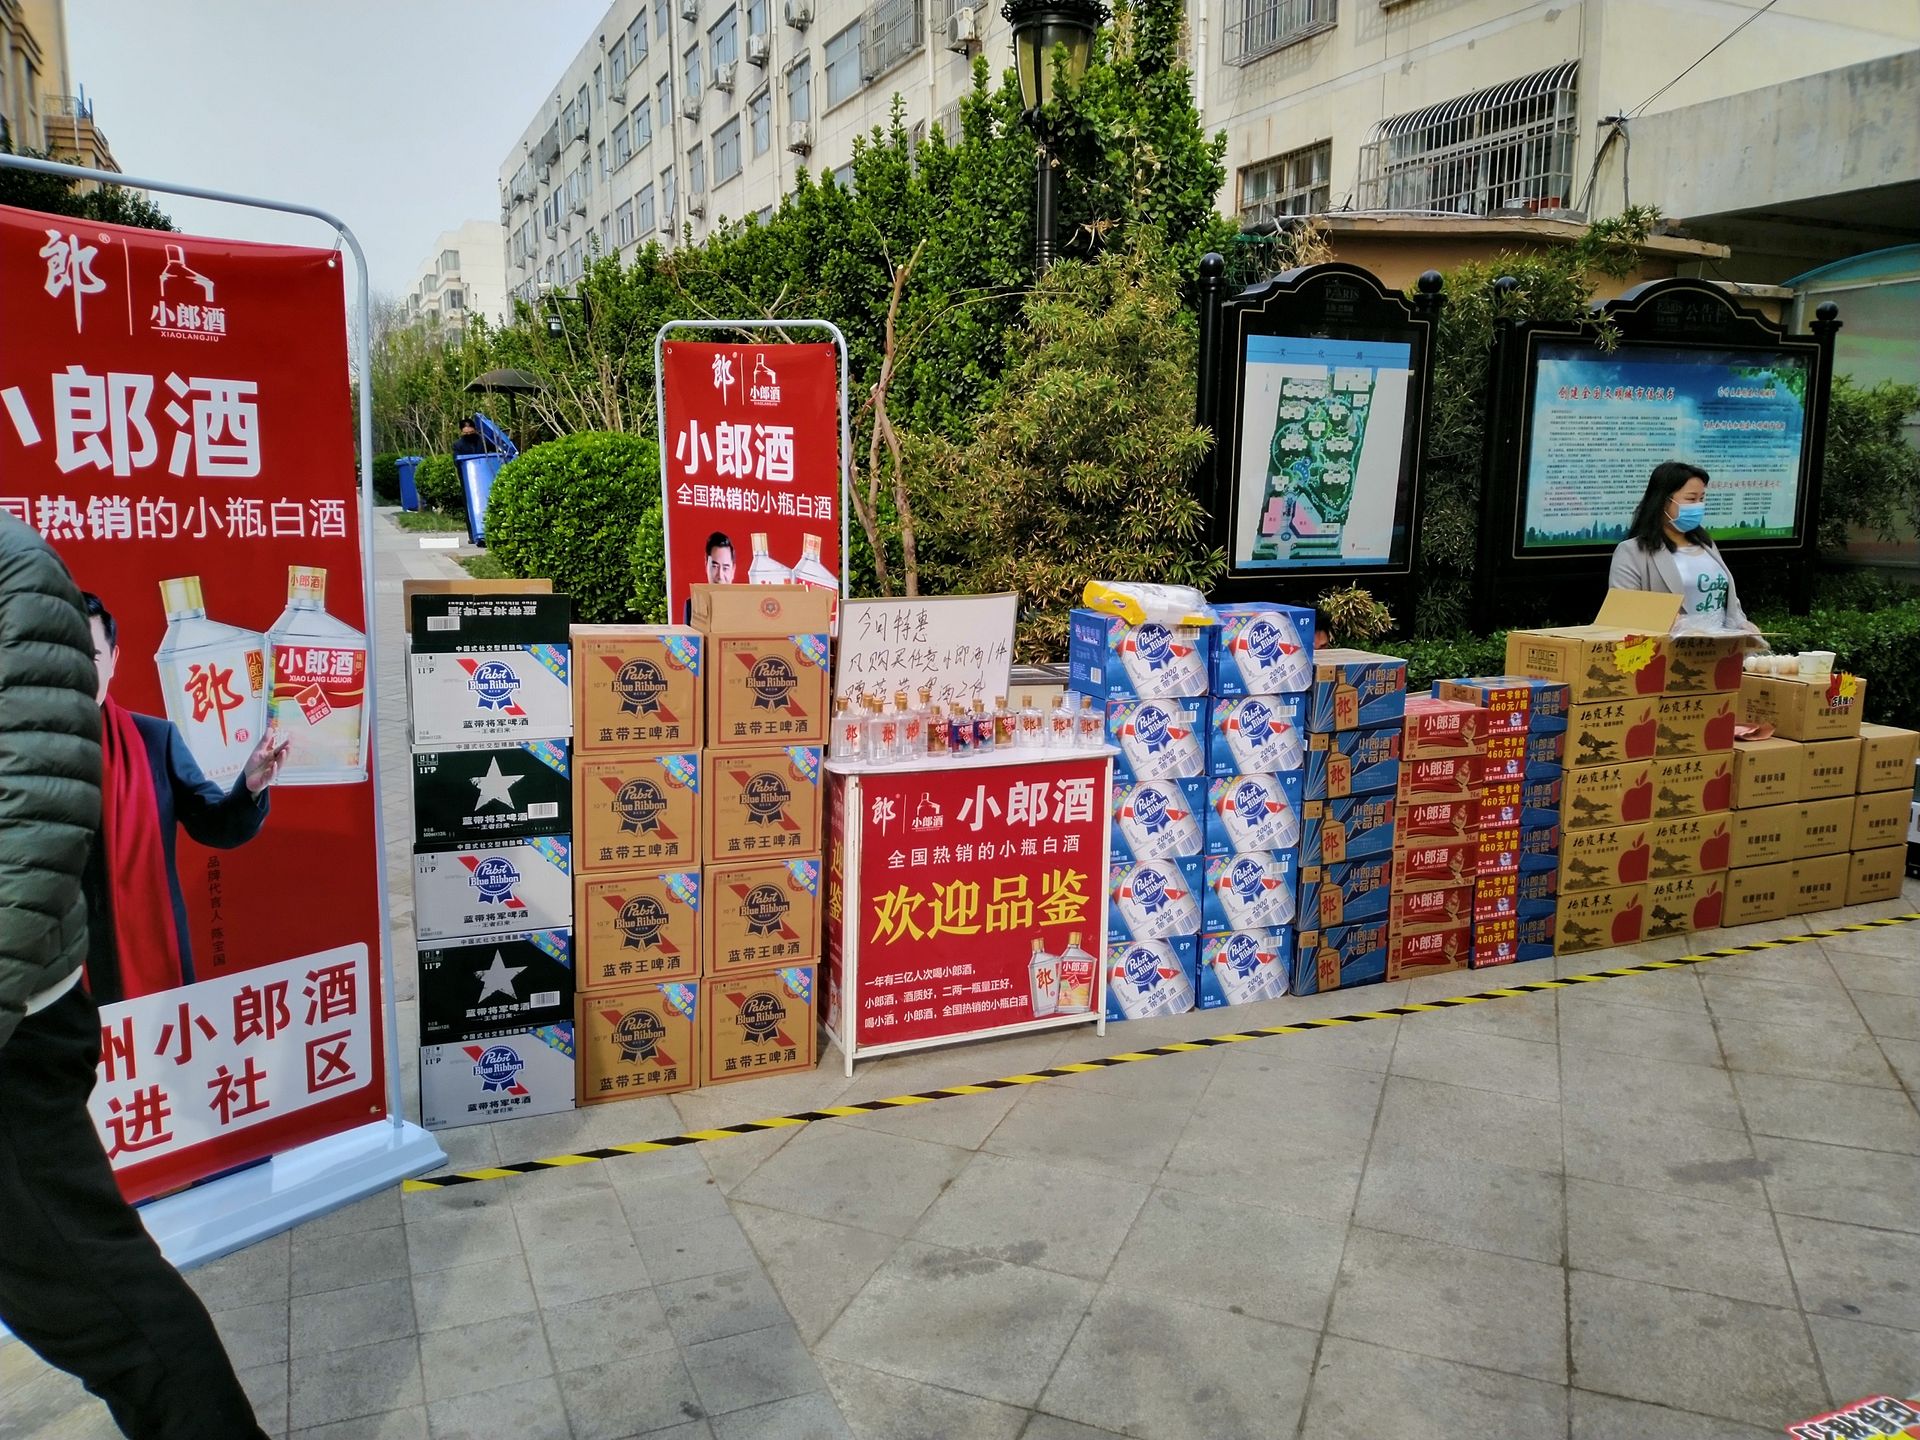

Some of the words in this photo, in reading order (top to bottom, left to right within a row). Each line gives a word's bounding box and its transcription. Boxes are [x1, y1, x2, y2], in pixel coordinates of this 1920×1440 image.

[39, 229, 106, 334] 郎
[150, 301, 226, 332] 小郎酒
[160, 331, 219, 342] XIAOLANGJIU
[712, 353, 735, 406] 郎
[750, 385, 780, 401] 小郎酒
[675, 420, 794, 482] 小郎酒
[676, 483, 832, 520] 全国热销的小瓶白酒
[290, 575, 321, 589] 小郎酒
[858, 606, 929, 643] 今日特惠
[279, 648, 353, 676] 小郎酒
[480, 667, 506, 679] Pabst
[625, 667, 653, 681] Pabst
[758, 664, 785, 677] Pabst
[1160, 667, 1178, 682] 2000
[1365, 668, 1397, 681] 小郎酒
[469, 680, 489, 690] Blue
[490, 678, 518, 689] Ribbon
[614, 681, 632, 692] Blue
[635, 680, 666, 691] Ribbon
[748, 677, 765, 688] Blue
[767, 675, 796, 687] Ribbon
[184, 662, 244, 748] 郎
[1337, 697, 1352, 725] 郎
[463, 718, 529, 728] 蓝带将军啤酒
[734, 720, 808, 736] 蓝带王啤酒
[1424, 714, 1460, 731] 小郎酒
[599, 725, 679, 742] 蓝带王啤酒
[1359, 737, 1390, 750] 小郎酒
[1418, 760, 1454, 777] 小郎酒
[752, 780, 778, 793] Pabst
[1330, 765, 1345, 792] 郎
[625, 785, 653, 799] Pabst
[741, 794, 758, 804] Blue
[760, 792, 789, 802] Ribbon
[613, 801, 632, 812] Blue
[635, 800, 666, 810] Ribbon
[956, 777, 1095, 832] 小郎酒
[1352, 803, 1385, 817] 小郎酒
[462, 812, 528, 825] 蓝带将军啤酒
[872, 796, 896, 837] 郎
[1414, 805, 1451, 821] 小郎酒
[912, 815, 944, 828] 小郎酒
[728, 833, 801, 851] 蓝带王啤酒
[599, 842, 678, 861] 蓝带王啤酒
[888, 834, 1080, 868] 全国热销的小瓶白酒
[1412, 849, 1449, 866] 小郎酒
[481, 864, 507, 875] Pabst
[1350, 866, 1381, 879] 小郎酒
[470, 877, 489, 886] Blue
[490, 873, 518, 884] Ribbon
[207, 856, 223, 922] 品牌代言人
[870, 868, 1090, 946] 欢迎品鉴
[1409, 892, 1444, 909] 小郎酒
[464, 910, 528, 923] 蓝带将军啤酒
[627, 902, 655, 917] Pabst
[616, 919, 636, 929] Blue
[637, 915, 668, 926] Ribbon
[211, 928, 225, 967] 陈宝国
[1408, 934, 1443, 952] 小郎酒
[728, 942, 800, 962] 蓝带王啤酒
[603, 956, 681, 977] 蓝带王啤酒
[1062, 962, 1088, 973] 小郎酒
[1036, 968, 1054, 1000] 郎
[466, 1002, 530, 1018] 蓝带将军啤酒
[748, 1000, 773, 1013] Pabst
[737, 1014, 754, 1025] Blue
[756, 1011, 784, 1022] Ribbon
[486, 1052, 511, 1065] Pabst
[725, 1048, 796, 1071] 蓝带王啤酒
[475, 1066, 493, 1076] Blue
[494, 1063, 522, 1073] Ribbon
[600, 1068, 677, 1091] 蓝带王啤酒
[468, 1096, 531, 1112] 蓝带将军啤酒
